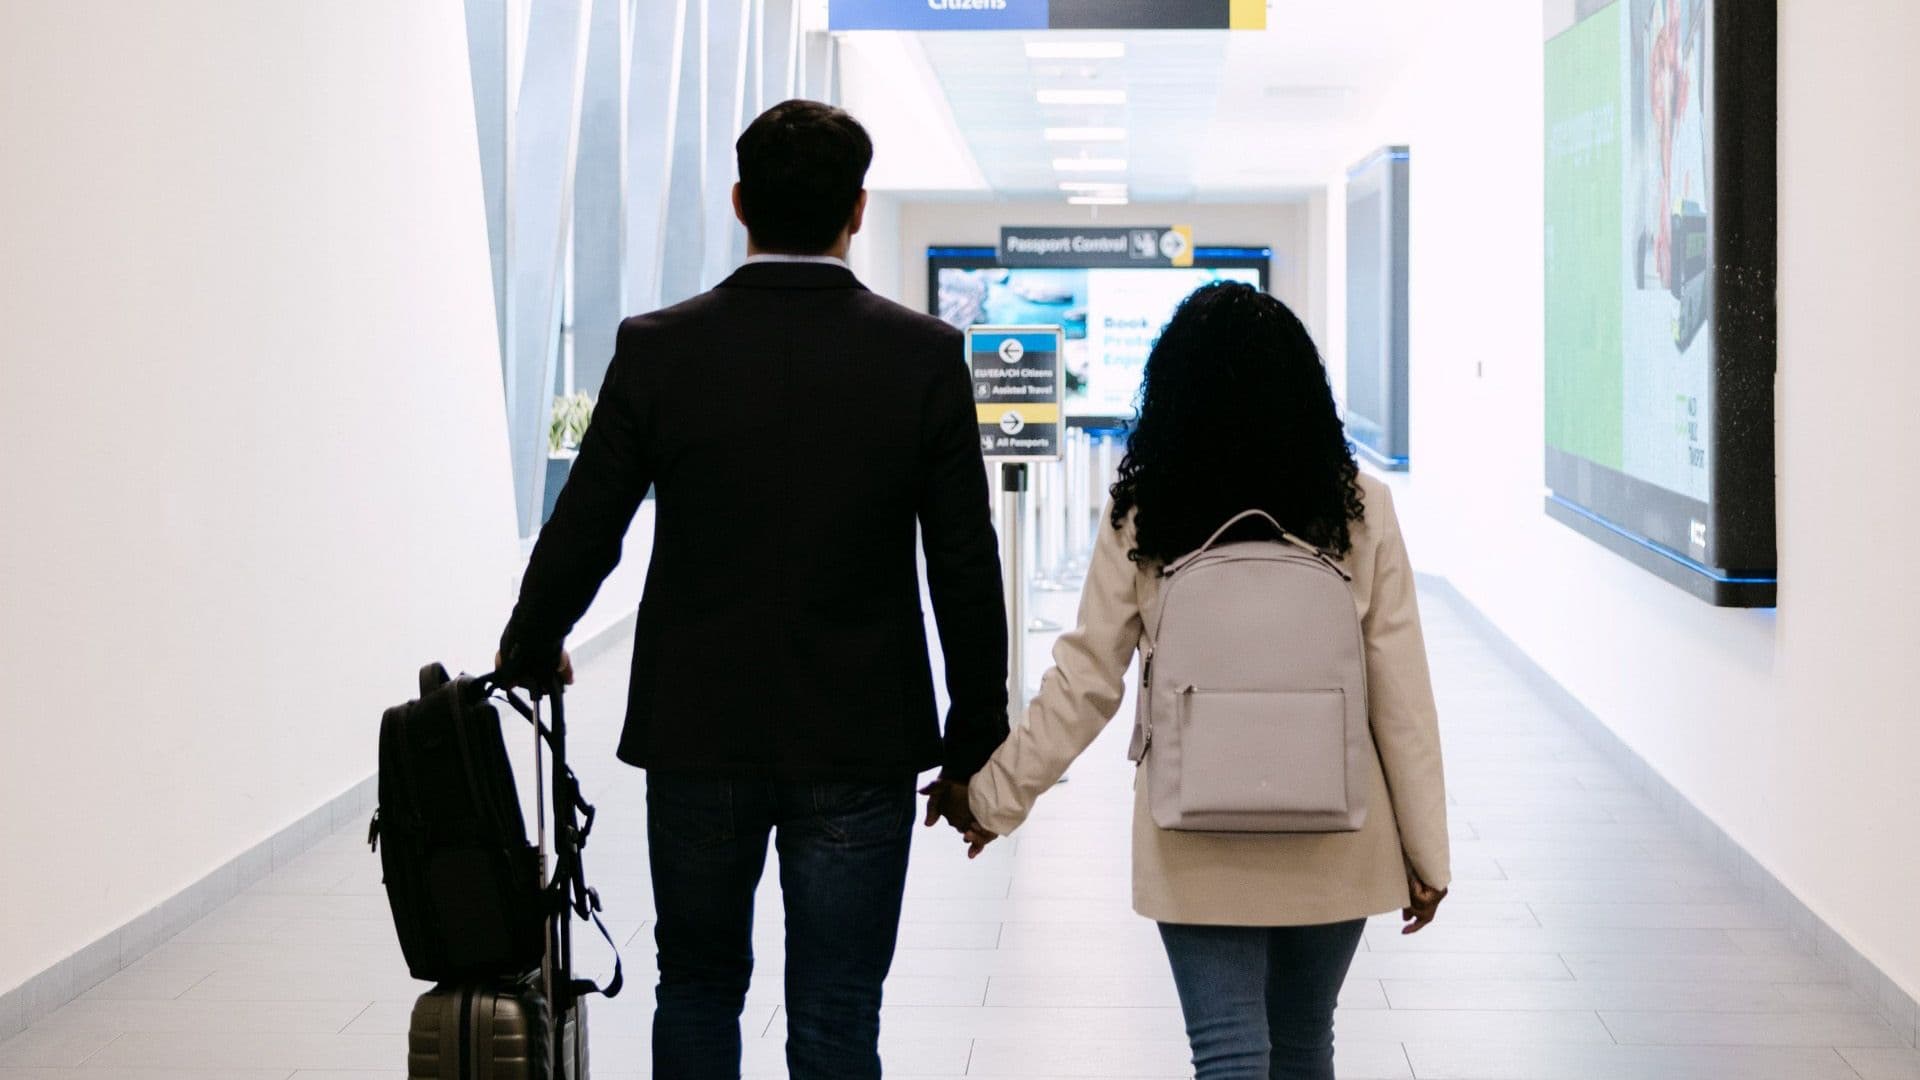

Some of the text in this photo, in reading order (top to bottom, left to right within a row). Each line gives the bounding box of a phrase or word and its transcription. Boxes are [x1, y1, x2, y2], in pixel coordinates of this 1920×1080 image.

[1007, 235, 1128, 255] Passport Control
[1021, 368, 1053, 378] Citizens
[992, 385, 1053, 395] Assisted Travel
[996, 437, 1050, 448] All Passports
